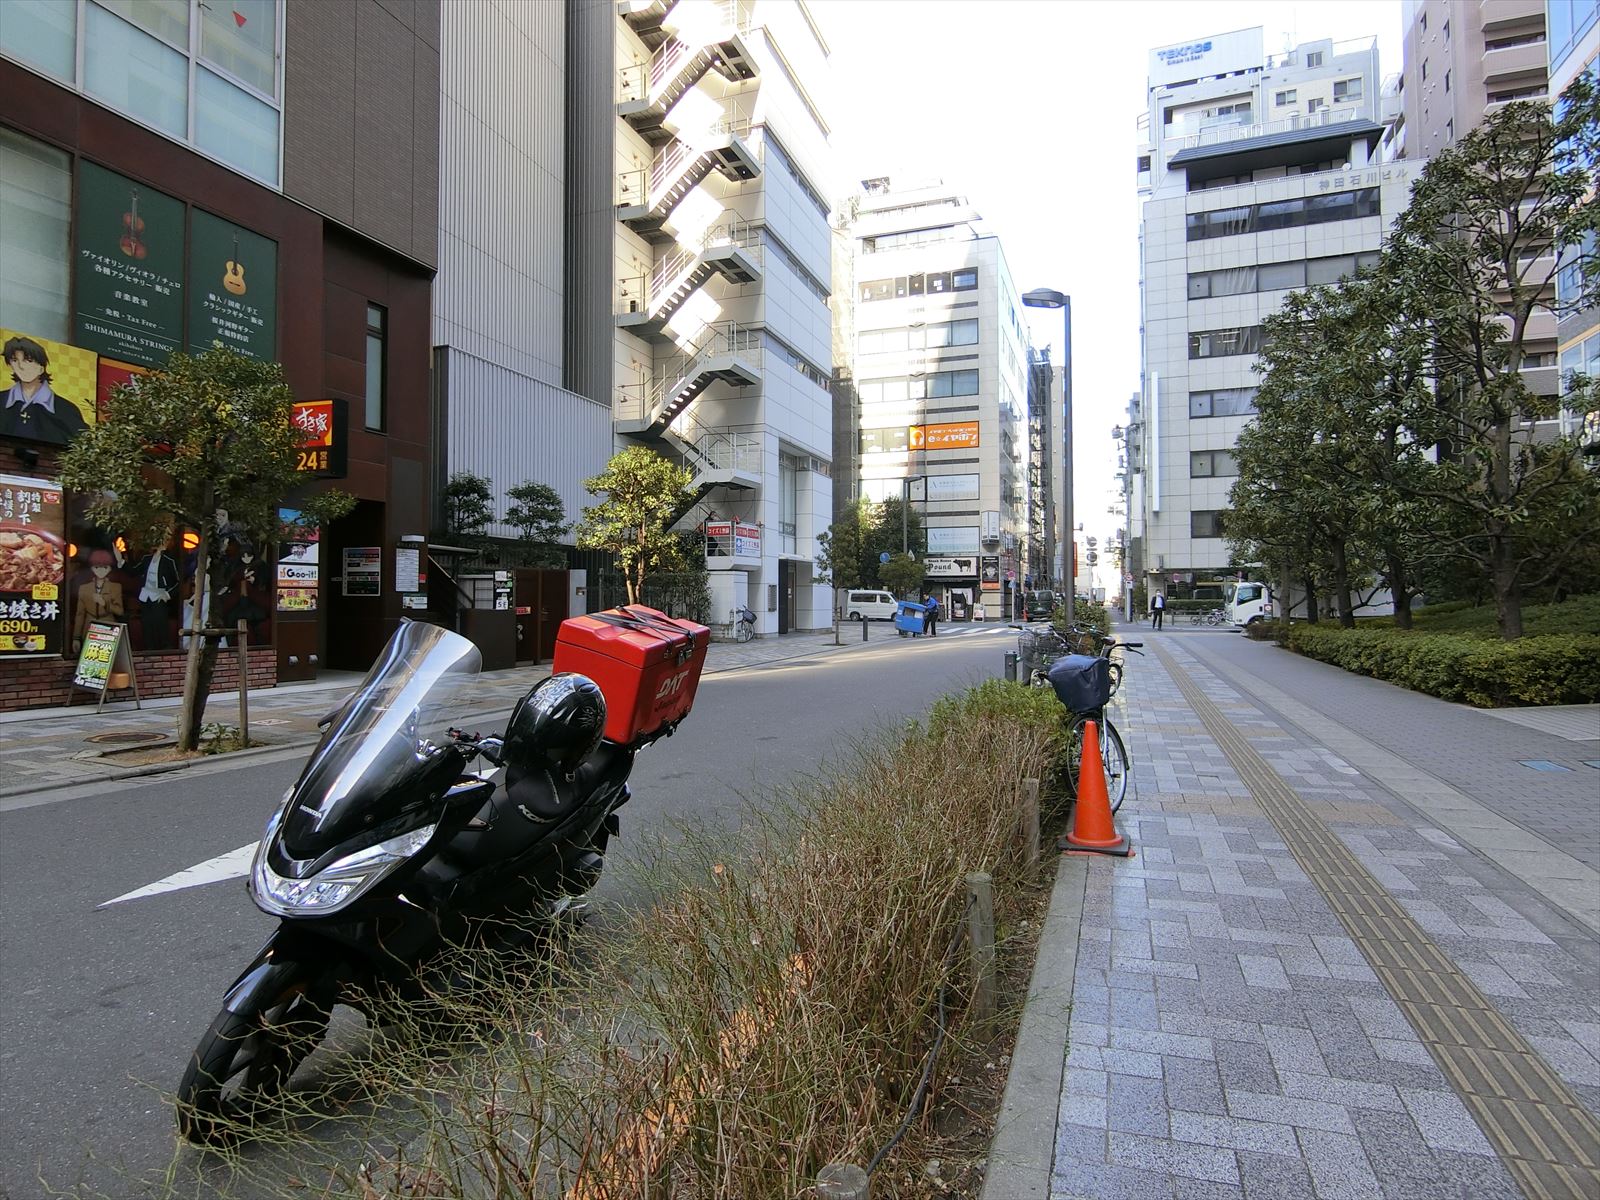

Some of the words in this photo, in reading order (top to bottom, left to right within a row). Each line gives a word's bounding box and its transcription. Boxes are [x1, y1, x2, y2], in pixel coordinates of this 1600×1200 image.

[1319, 168, 1408, 191] 神田石川ビル
[114, 290, 149, 308] 音楽教室
[84, 322, 138, 343] SHIMAMURA
[296, 406, 328, 434] すき家
[16, 490, 32, 526] 割り下
[31, 491, 42, 513] 特製
[926, 563, 952, 573] Pound
[84, 642, 113, 663] 麻雀
[655, 669, 690, 700] DAT
[299, 804, 322, 818] HONDA
